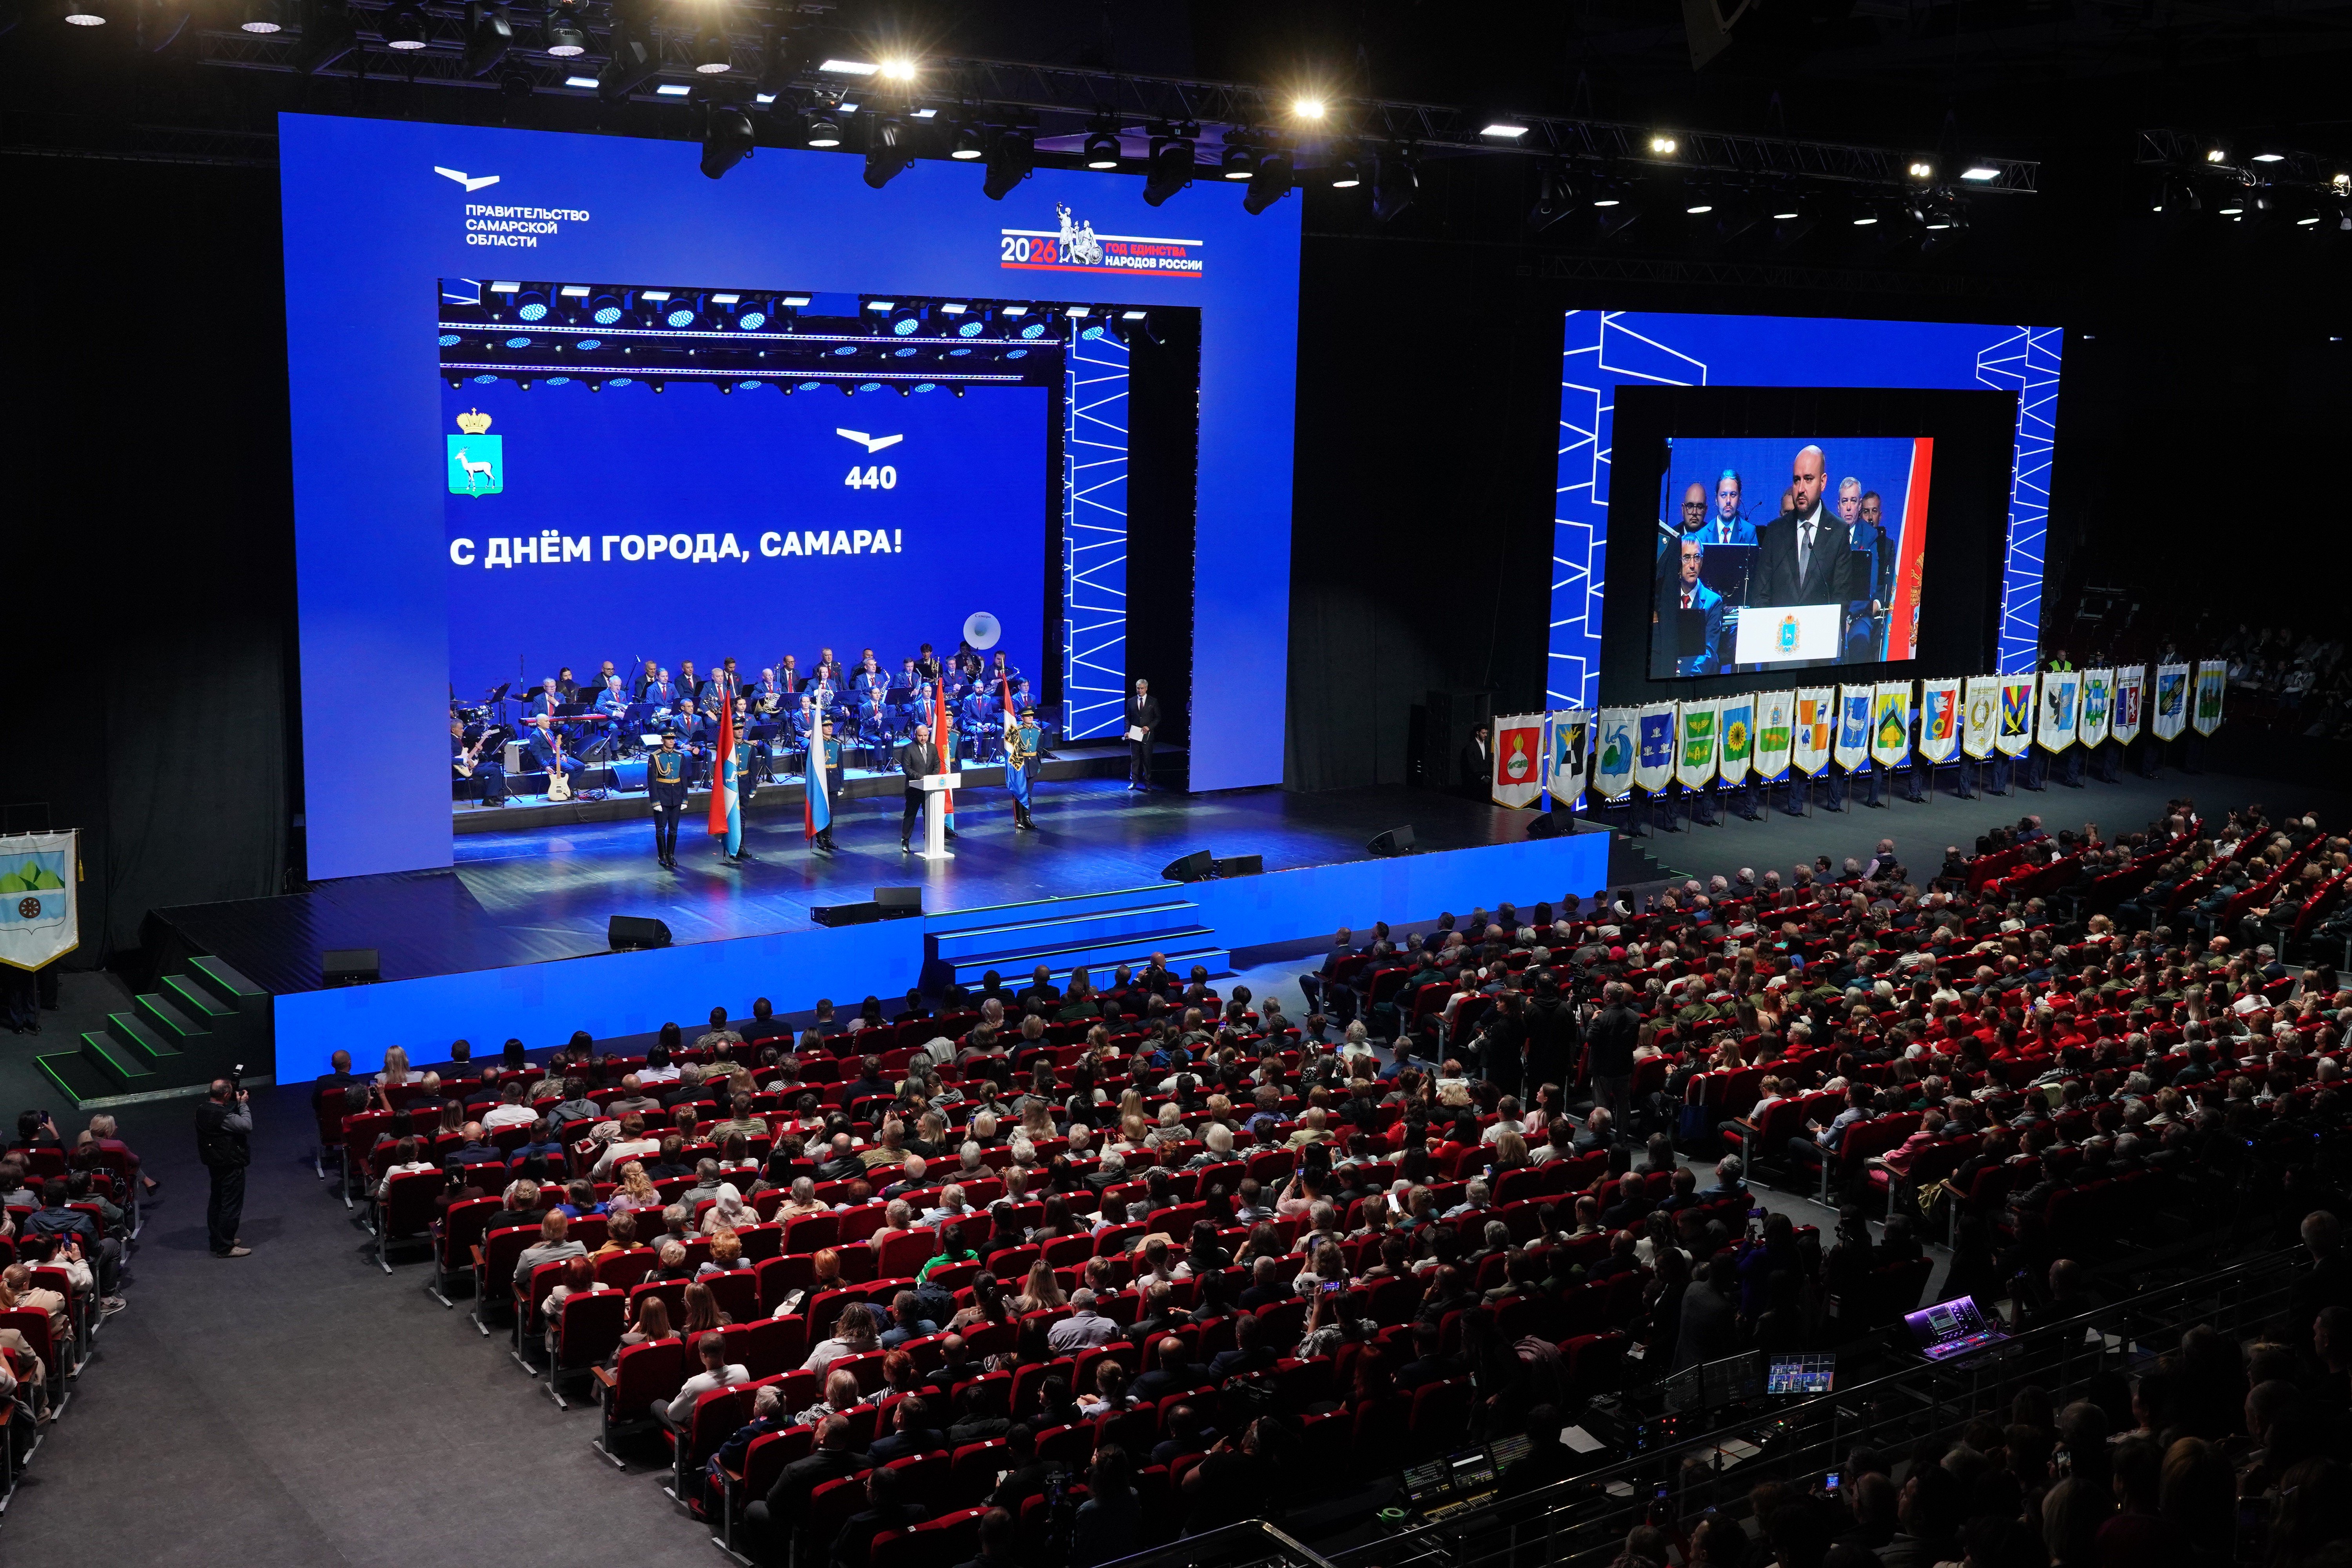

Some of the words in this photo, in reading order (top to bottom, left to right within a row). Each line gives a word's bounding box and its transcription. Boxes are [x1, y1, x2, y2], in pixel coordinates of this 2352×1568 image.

[466, 204, 590, 221] ПРАВИТЕЛЬСТВО
[466, 219, 557, 234] САМАРСКОЙ
[466, 233, 537, 247] ОБЛАСТИ
[1001, 237, 1057, 263] 2026
[1106, 243, 1128, 255] ГОД
[1131, 244, 1186, 257] ЕДИНСТВА
[1105, 255, 1157, 269] НАРОДОВ
[1159, 258, 1202, 270] РОССИИ
[845, 465, 897, 490] 440
[450, 538, 475, 565] С
[485, 529, 591, 569] ДНЁМ
[602, 533, 750, 563] ГОРОДА,
[760, 529, 902, 557] САМАРА!
